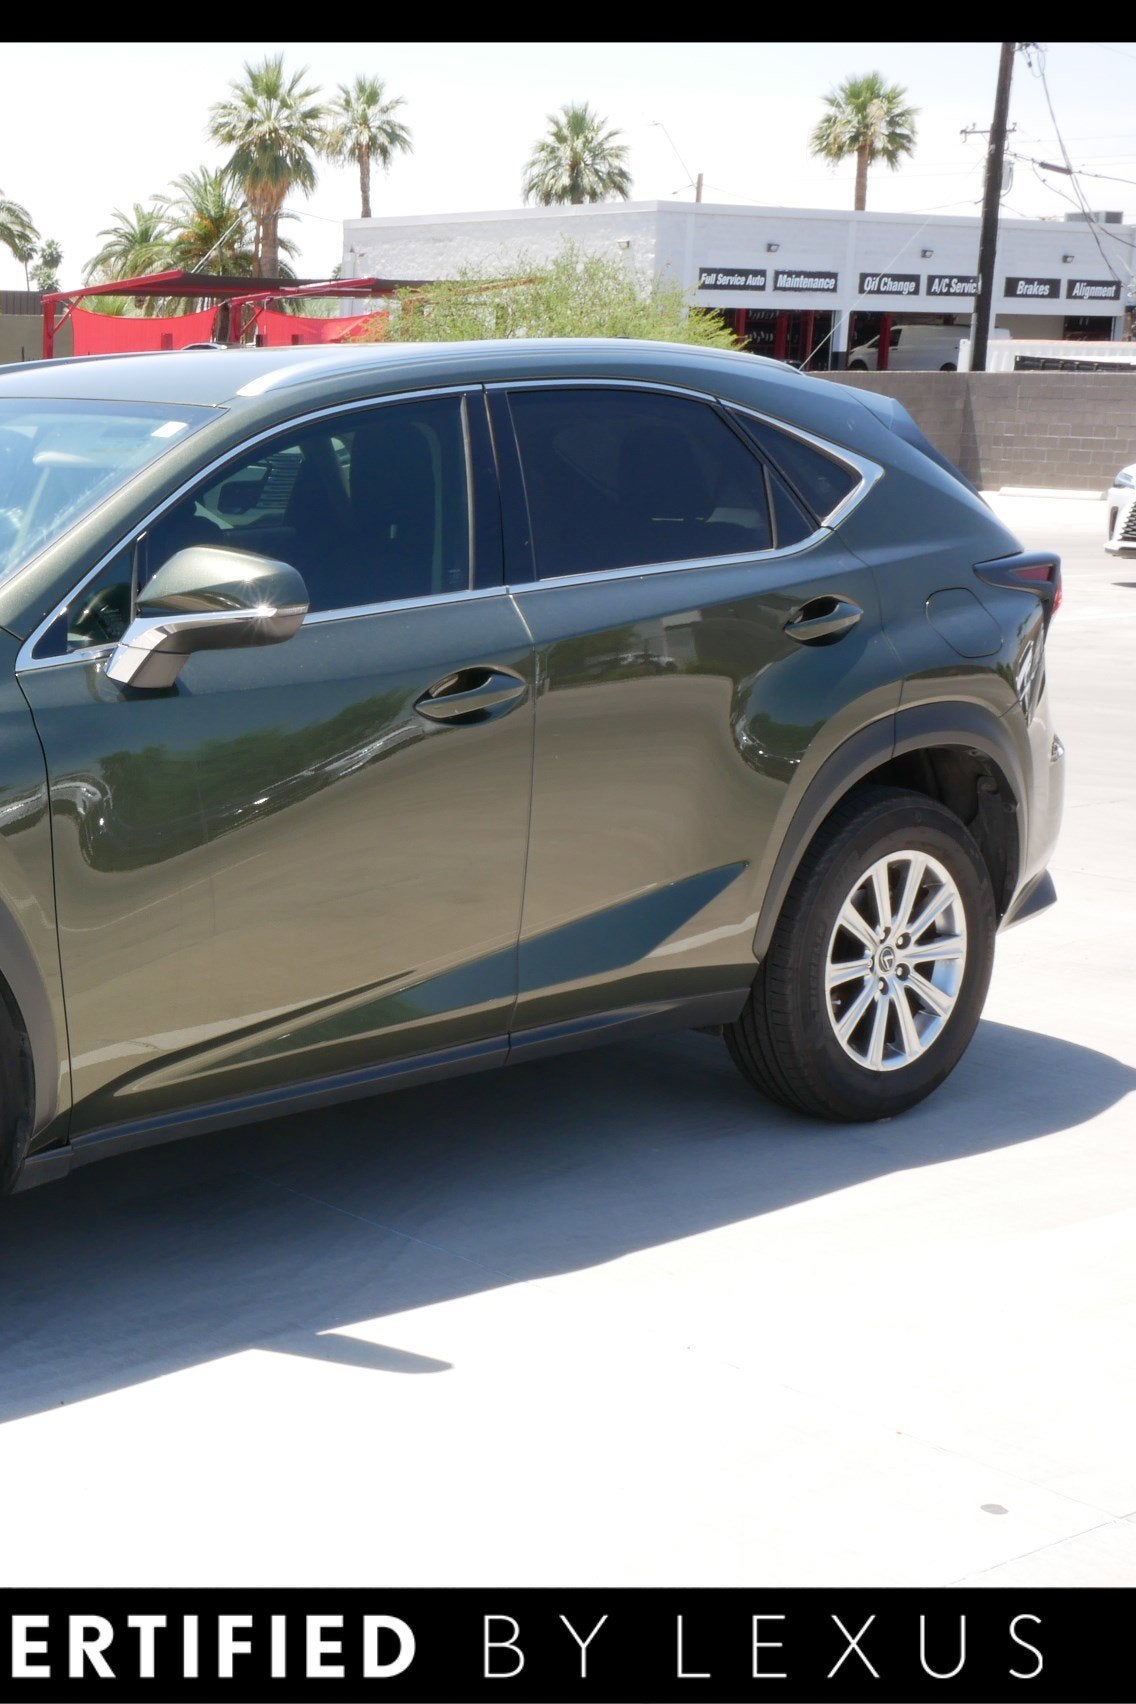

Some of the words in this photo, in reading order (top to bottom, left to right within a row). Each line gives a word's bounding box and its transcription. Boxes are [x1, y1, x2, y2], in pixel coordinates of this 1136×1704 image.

[701, 273, 717, 285] Full
[716, 273, 746, 286] Service
[745, 274, 765, 286] Auto
[776, 273, 836, 290] Maintenance
[864, 276, 879, 291] Oil
[880, 277, 916, 295] Change
[930, 278, 950, 294] A/C
[949, 278, 977, 293] Servic
[1016, 280, 1050, 296] Brakes
[1072, 281, 1117, 299] Alignment
